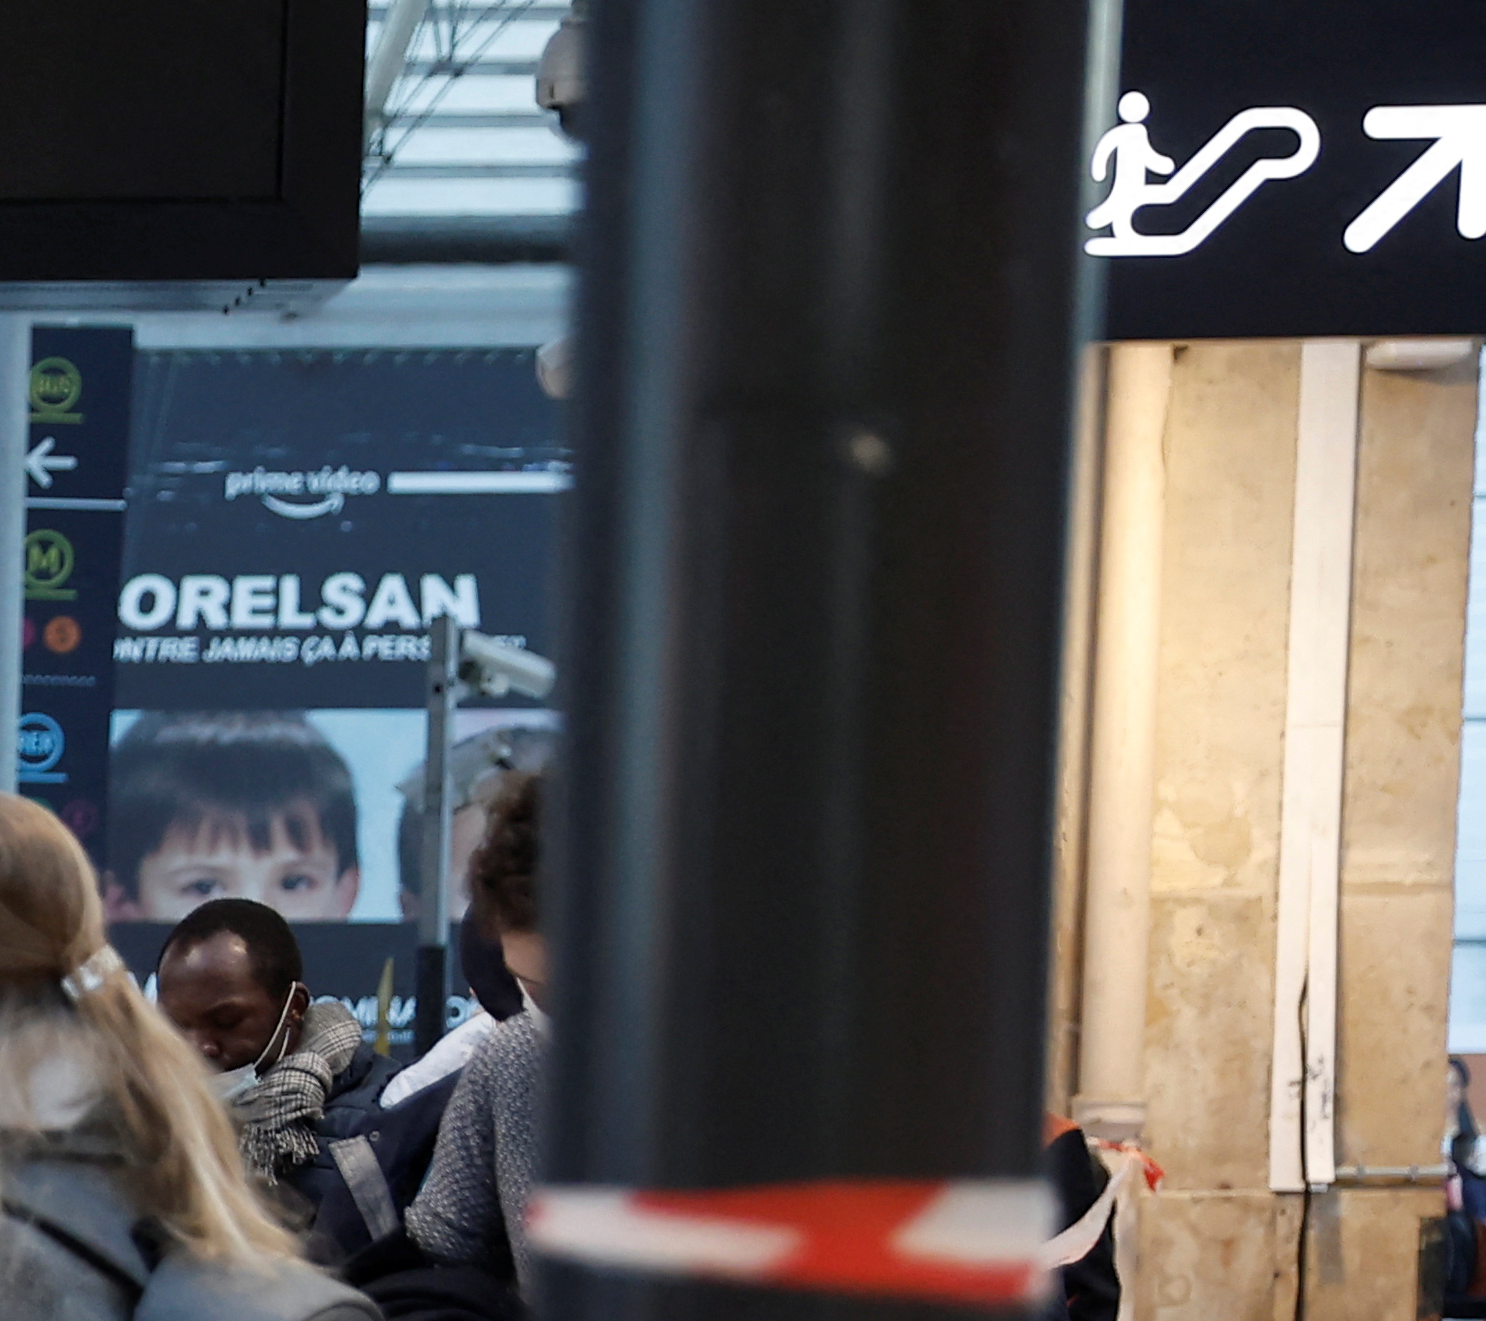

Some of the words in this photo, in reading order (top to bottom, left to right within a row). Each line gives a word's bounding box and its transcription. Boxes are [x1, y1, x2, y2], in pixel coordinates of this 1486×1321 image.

[225, 465, 304, 500] prime
[306, 465, 381, 495] video
[117, 572, 482, 631] ORELSAN
[202, 635, 299, 663] JAMAIS
[301, 634, 337, 667] ÇA
[338, 629, 361, 661] À
